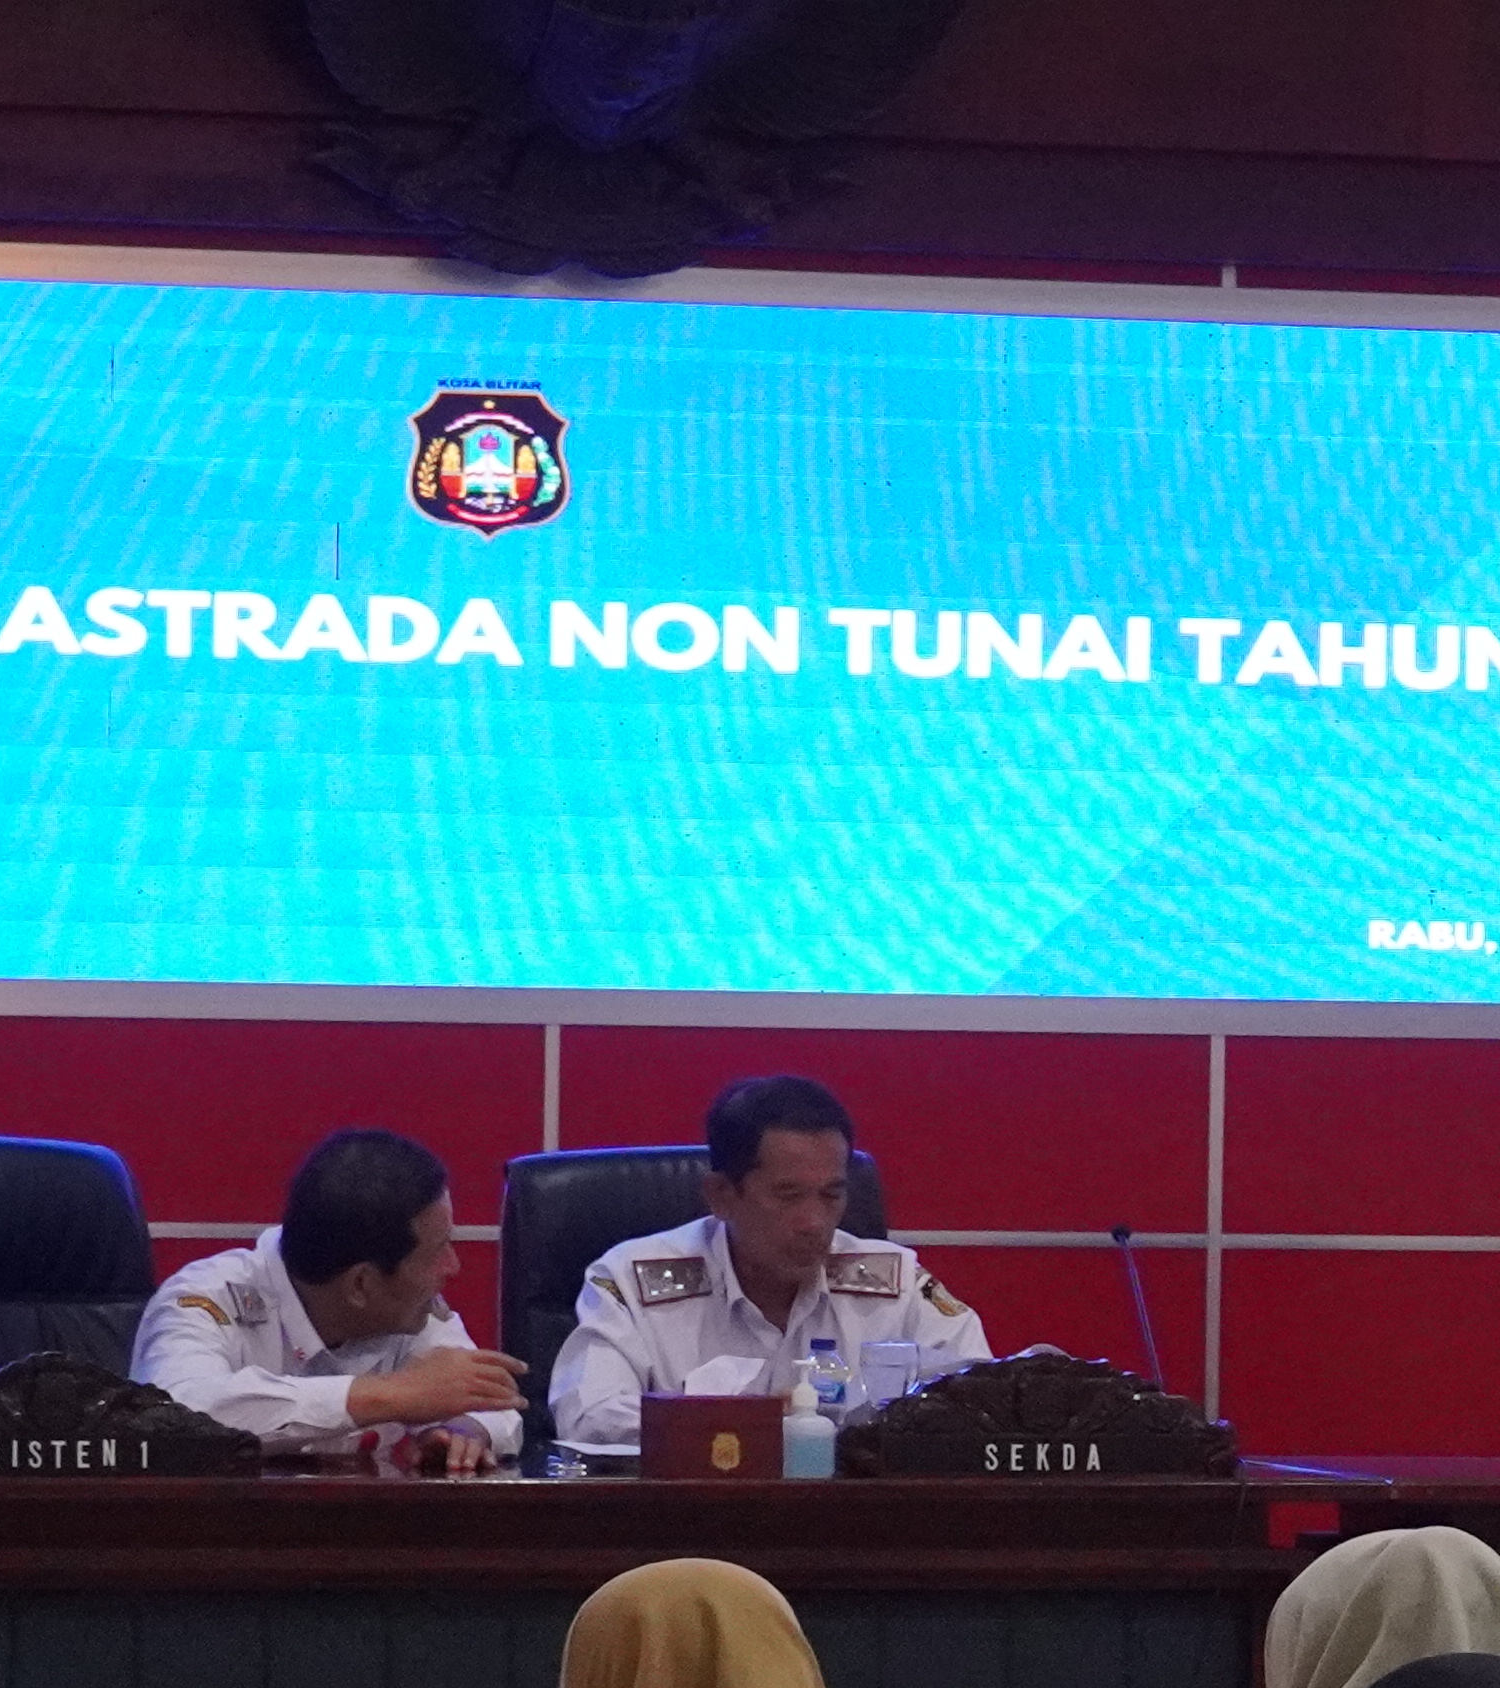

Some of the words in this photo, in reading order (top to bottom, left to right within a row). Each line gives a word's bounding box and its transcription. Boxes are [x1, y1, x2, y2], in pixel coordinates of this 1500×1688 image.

[550, 600, 799, 675] NON
[829, 607, 1151, 680] TUNAI
[1368, 919, 1496, 958] RABU,
[984, 1443, 1101, 1472] SEKDA
